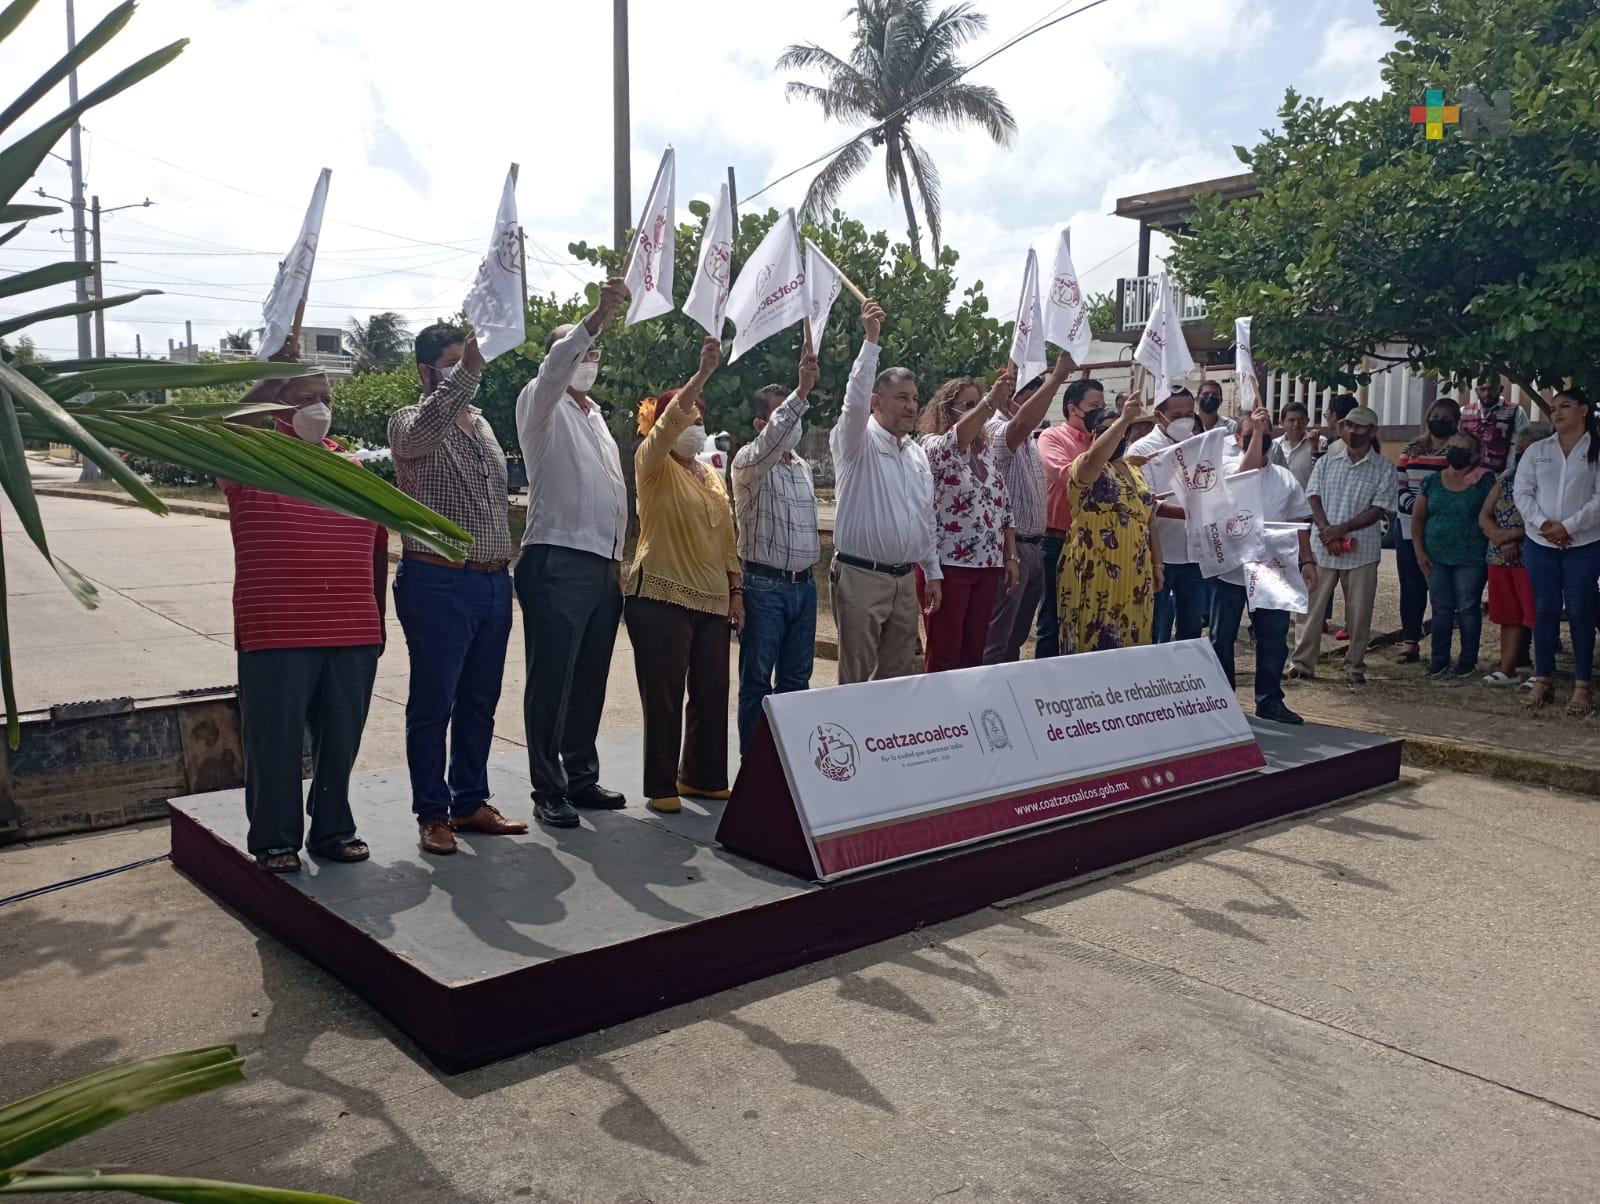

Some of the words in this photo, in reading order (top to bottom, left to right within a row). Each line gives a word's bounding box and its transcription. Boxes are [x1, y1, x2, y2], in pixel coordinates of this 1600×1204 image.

[1034, 691, 1105, 718] Programa
[1105, 686, 1123, 704] de
[1124, 673, 1207, 702] rehabilitación
[865, 723, 969, 753] Coatzacoalcos
[1046, 724, 1065, 742] de
[1066, 717, 1101, 739] calles
[1102, 716, 1124, 732] con
[1125, 706, 1175, 727] concreto
[1175, 696, 1228, 718] hidráulico
[1014, 780, 1130, 816] www.coatzacoalcos.gob.mx
